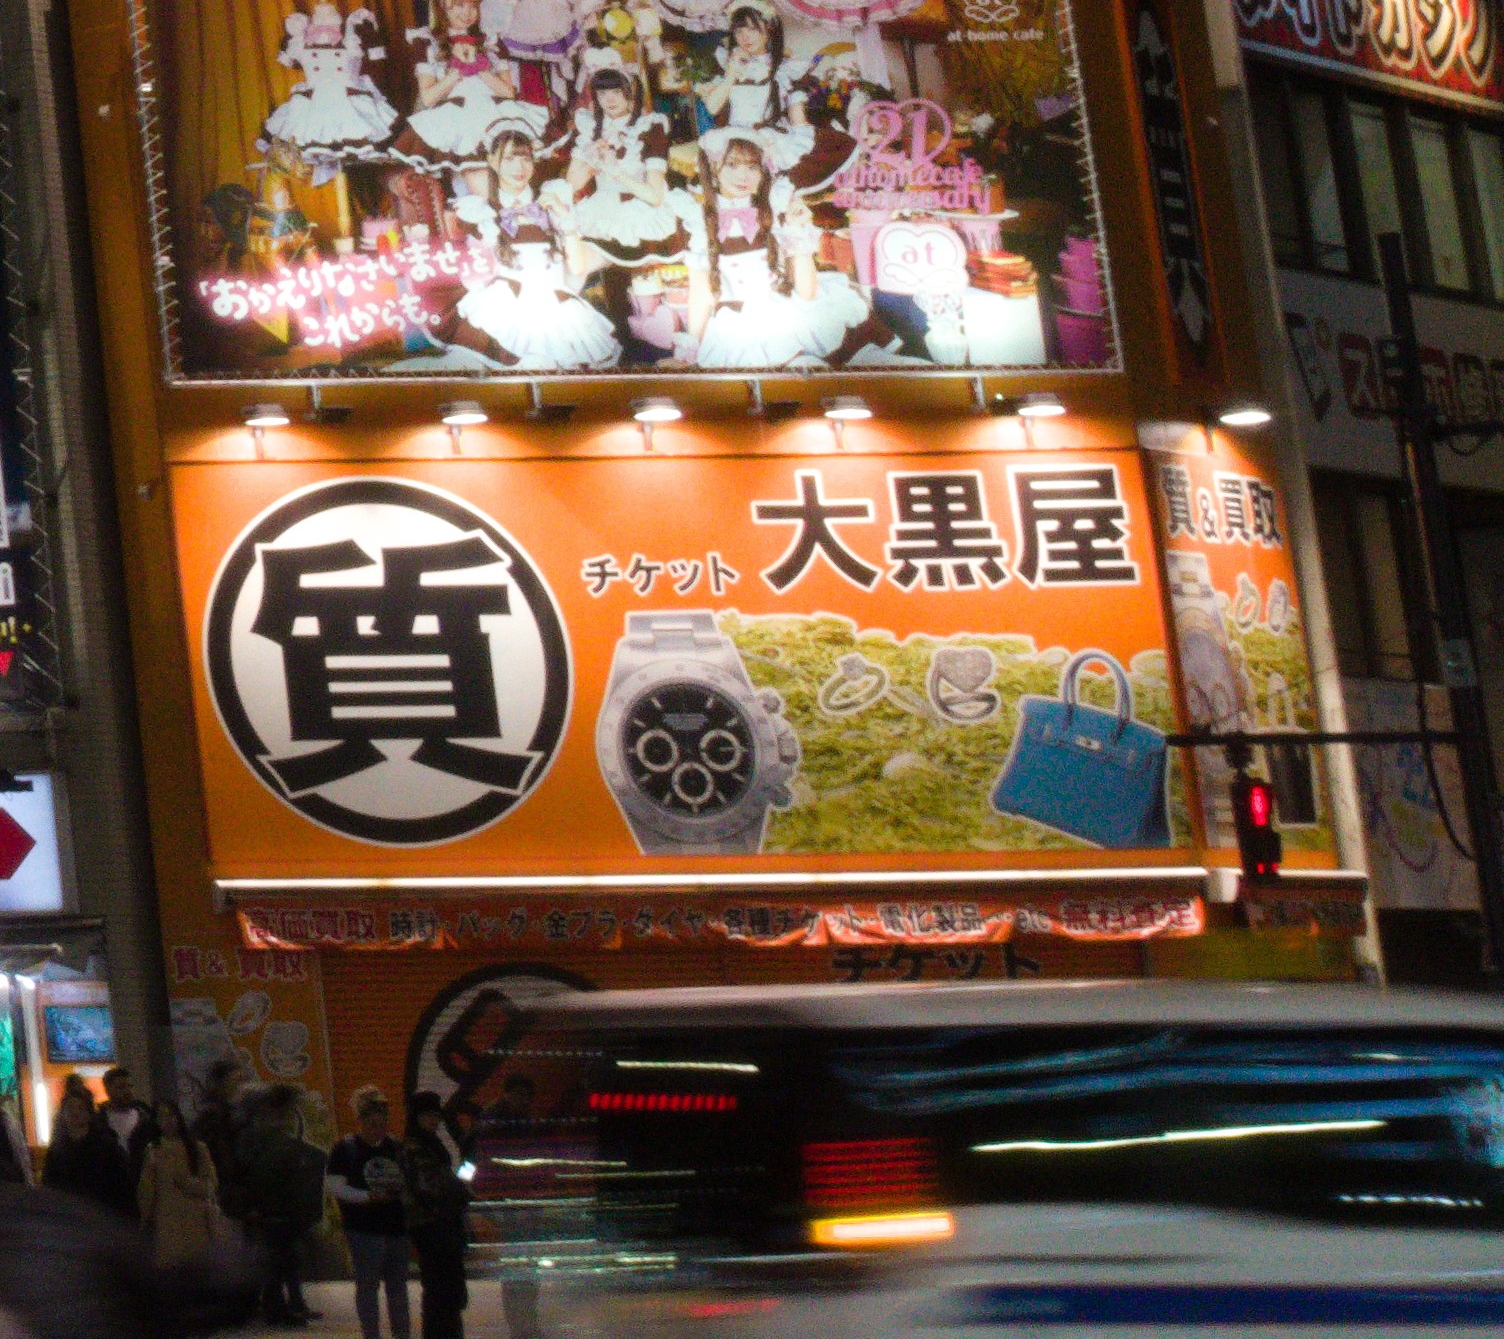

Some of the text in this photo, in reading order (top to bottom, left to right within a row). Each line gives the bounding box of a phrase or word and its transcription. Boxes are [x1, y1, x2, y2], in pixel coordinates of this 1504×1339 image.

[902, 241, 936, 265] at
[303, 292, 442, 348] これからも。
[753, 466, 1137, 592] 大黒屋
[581, 553, 739, 596] チケット
[251, 525, 545, 798] 質
